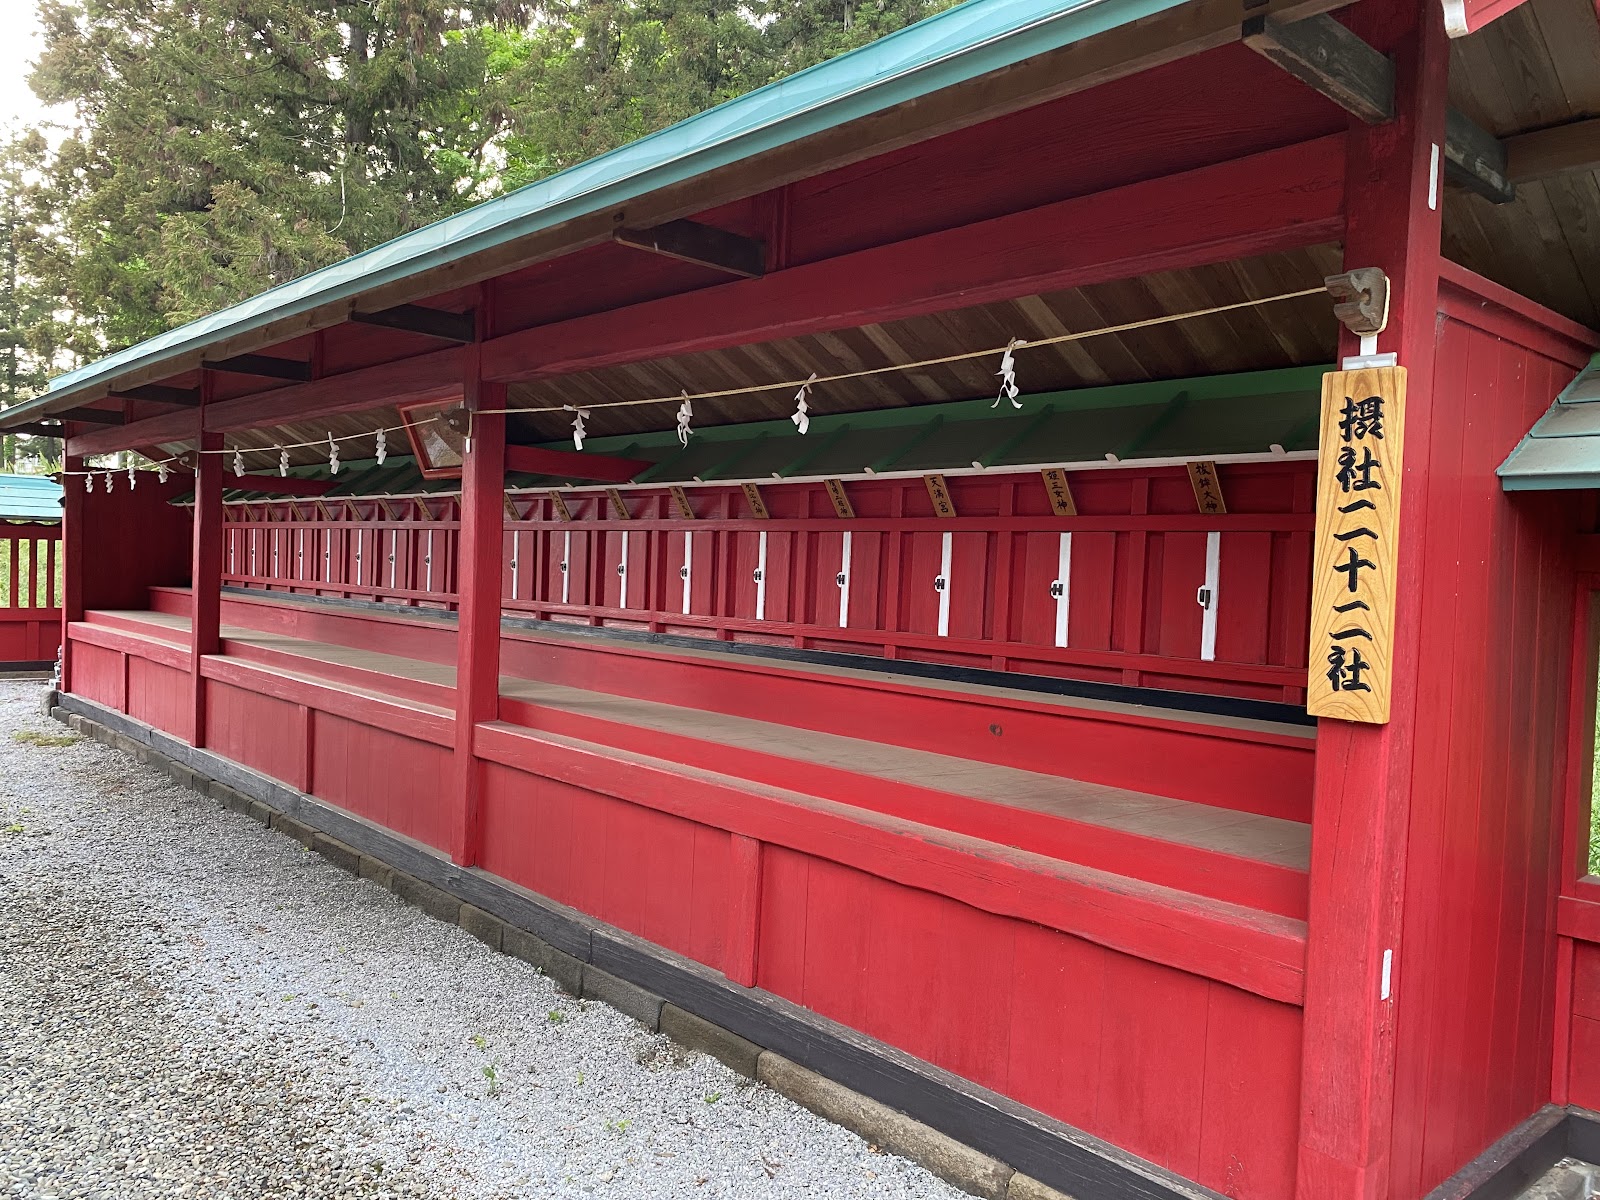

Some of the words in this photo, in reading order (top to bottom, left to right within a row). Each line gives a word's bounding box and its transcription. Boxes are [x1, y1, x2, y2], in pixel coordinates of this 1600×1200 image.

[929, 477, 949, 513] 天満宮
[1326, 396, 1385, 692] 摂社二十二社
